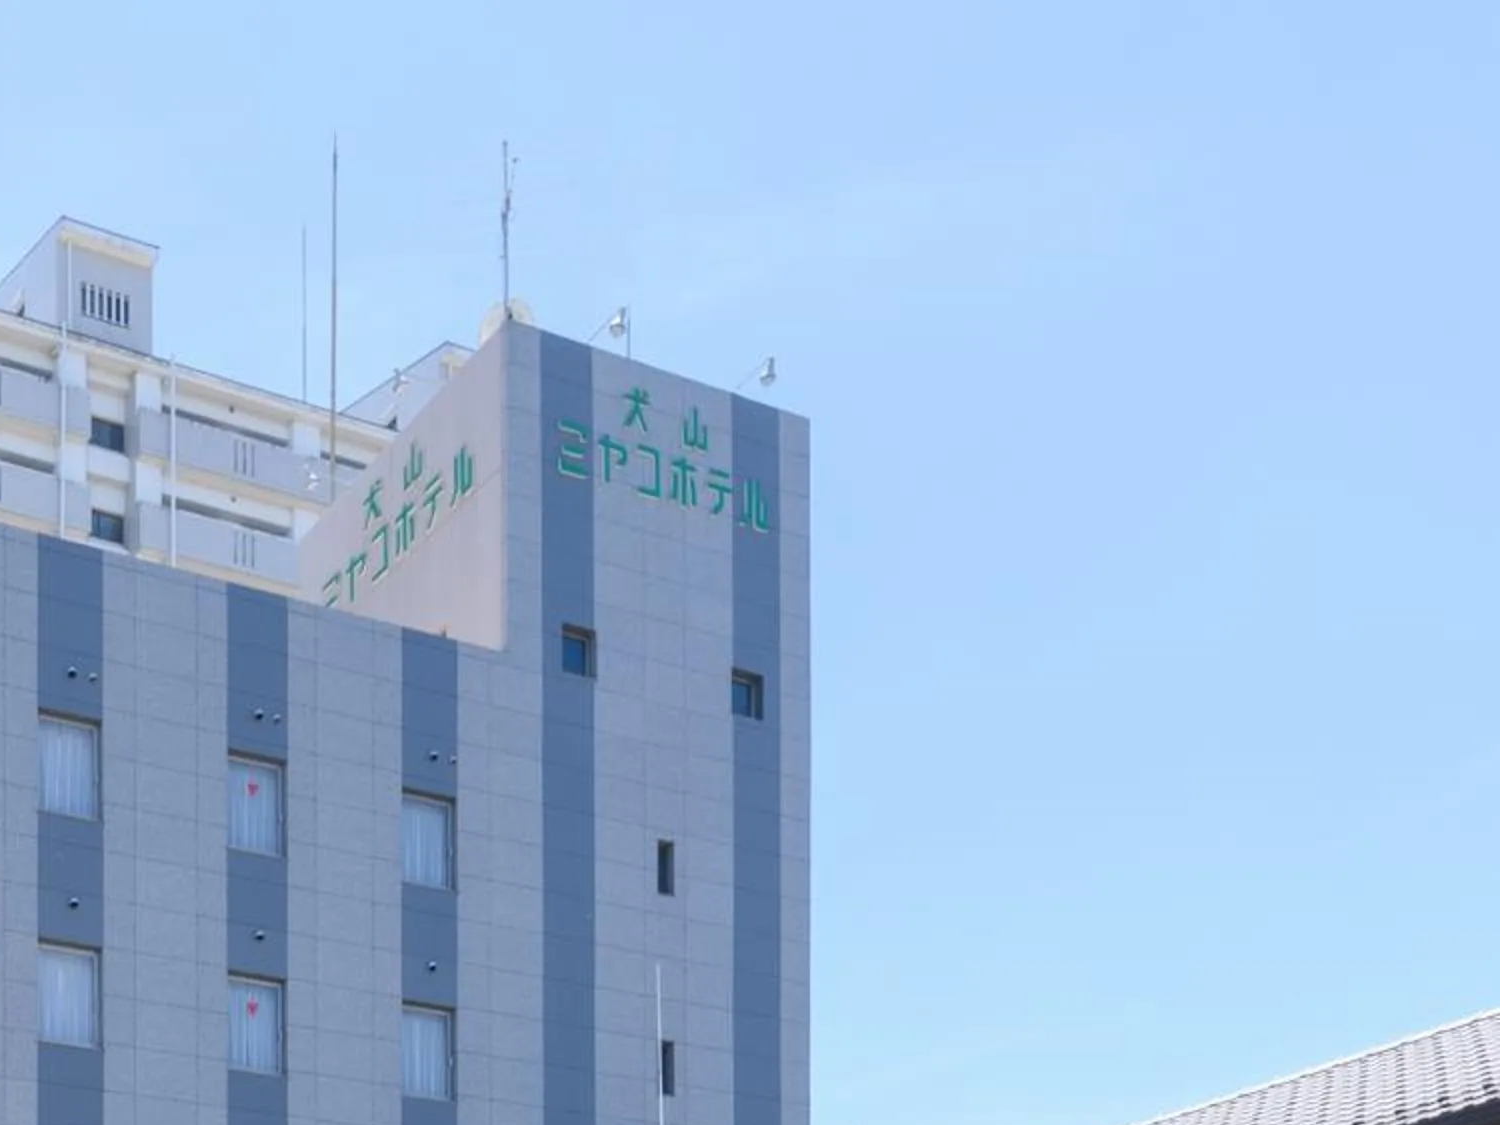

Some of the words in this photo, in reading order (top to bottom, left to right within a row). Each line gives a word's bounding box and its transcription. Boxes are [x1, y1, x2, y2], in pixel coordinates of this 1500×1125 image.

[623, 387, 708, 453] 犬山
[363, 441, 424, 531] 犬山
[558, 419, 770, 533] ミヤコホテル
